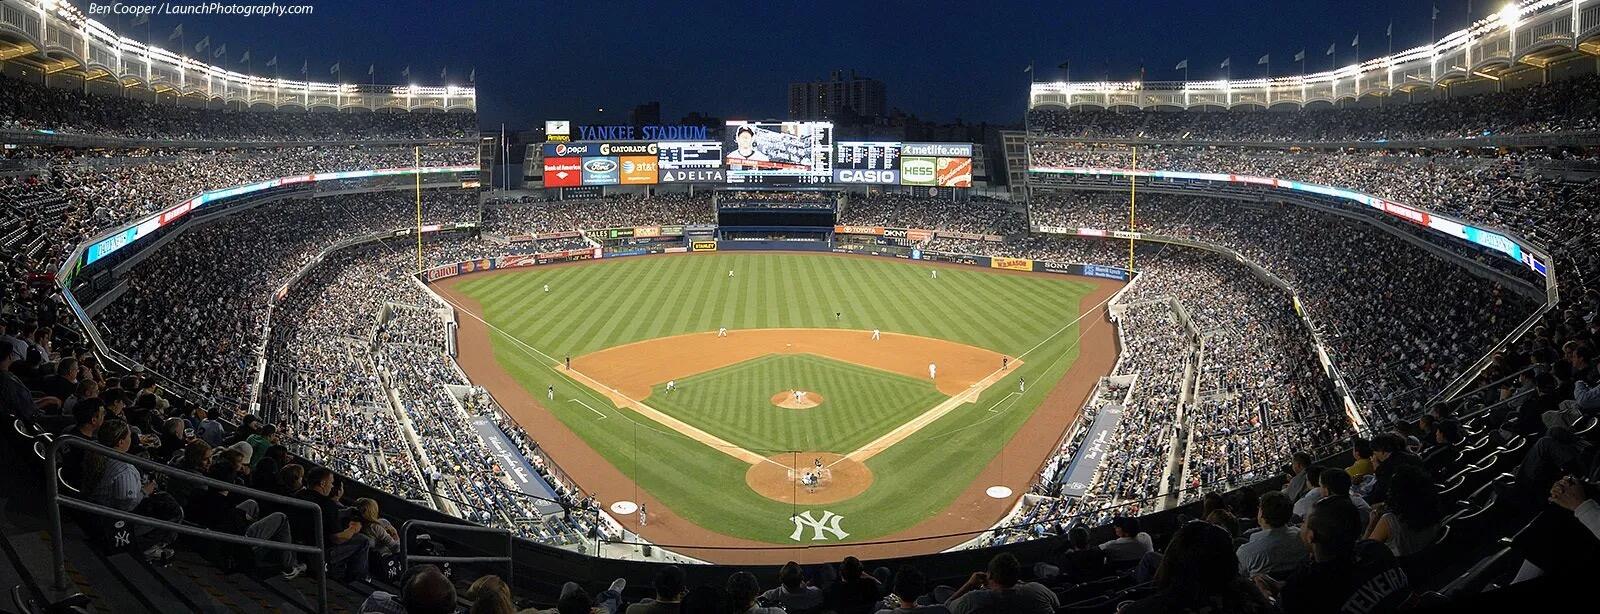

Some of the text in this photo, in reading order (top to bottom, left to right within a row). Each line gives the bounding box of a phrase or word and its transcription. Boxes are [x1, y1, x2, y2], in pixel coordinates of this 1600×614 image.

[578, 125, 708, 140] YANKEE STADIUM
[567, 146, 588, 154] pepsi
[600, 144, 610, 155] G
[912, 145, 970, 155] metlife.com
[591, 162, 610, 171] Ford
[636, 162, 656, 172] at&t
[904, 167, 933, 175] HESS
[677, 171, 722, 180] DELTA
[839, 170, 895, 183] CASIO
[428, 266, 457, 280] Canon
[789, 511, 850, 541] NY
[1341, 567, 1409, 614] TEIXEIRA
